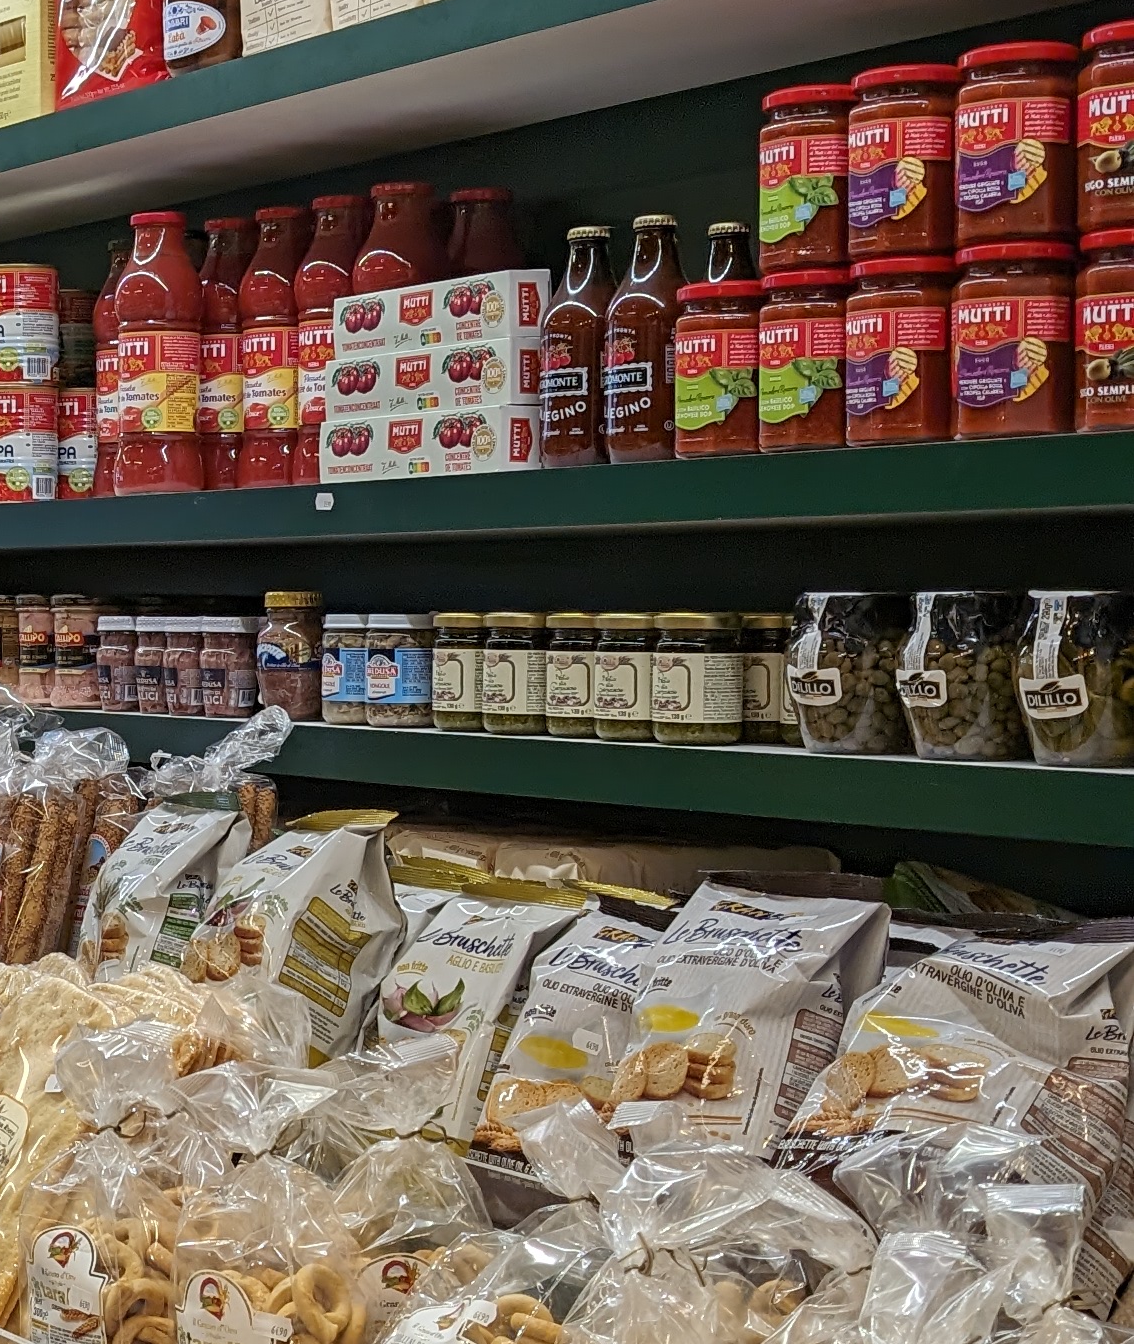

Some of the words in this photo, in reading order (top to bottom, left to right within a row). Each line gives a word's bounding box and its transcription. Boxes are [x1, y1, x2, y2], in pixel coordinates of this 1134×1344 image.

[958, 108, 1009, 129] MUTTI
[403, 296, 429, 310] MUTTI
[958, 305, 1011, 325] MUTTI
[299, 329, 334, 346] MUTT
[119, 340, 149, 357] UTTI
[399, 360, 426, 372] MUTTI
[125, 392, 160, 402] Tomates
[251, 388, 287, 399] Tomates
[392, 424, 418, 437] MUTTI
[512, 423, 521, 457] MUTTI
[446, 955, 472, 971] AGLIO
[675, 955, 738, 967] EXTRAVERGINE
[950, 964, 973, 984] OLIO
[975, 978, 1015, 1003] D'OLIVA
